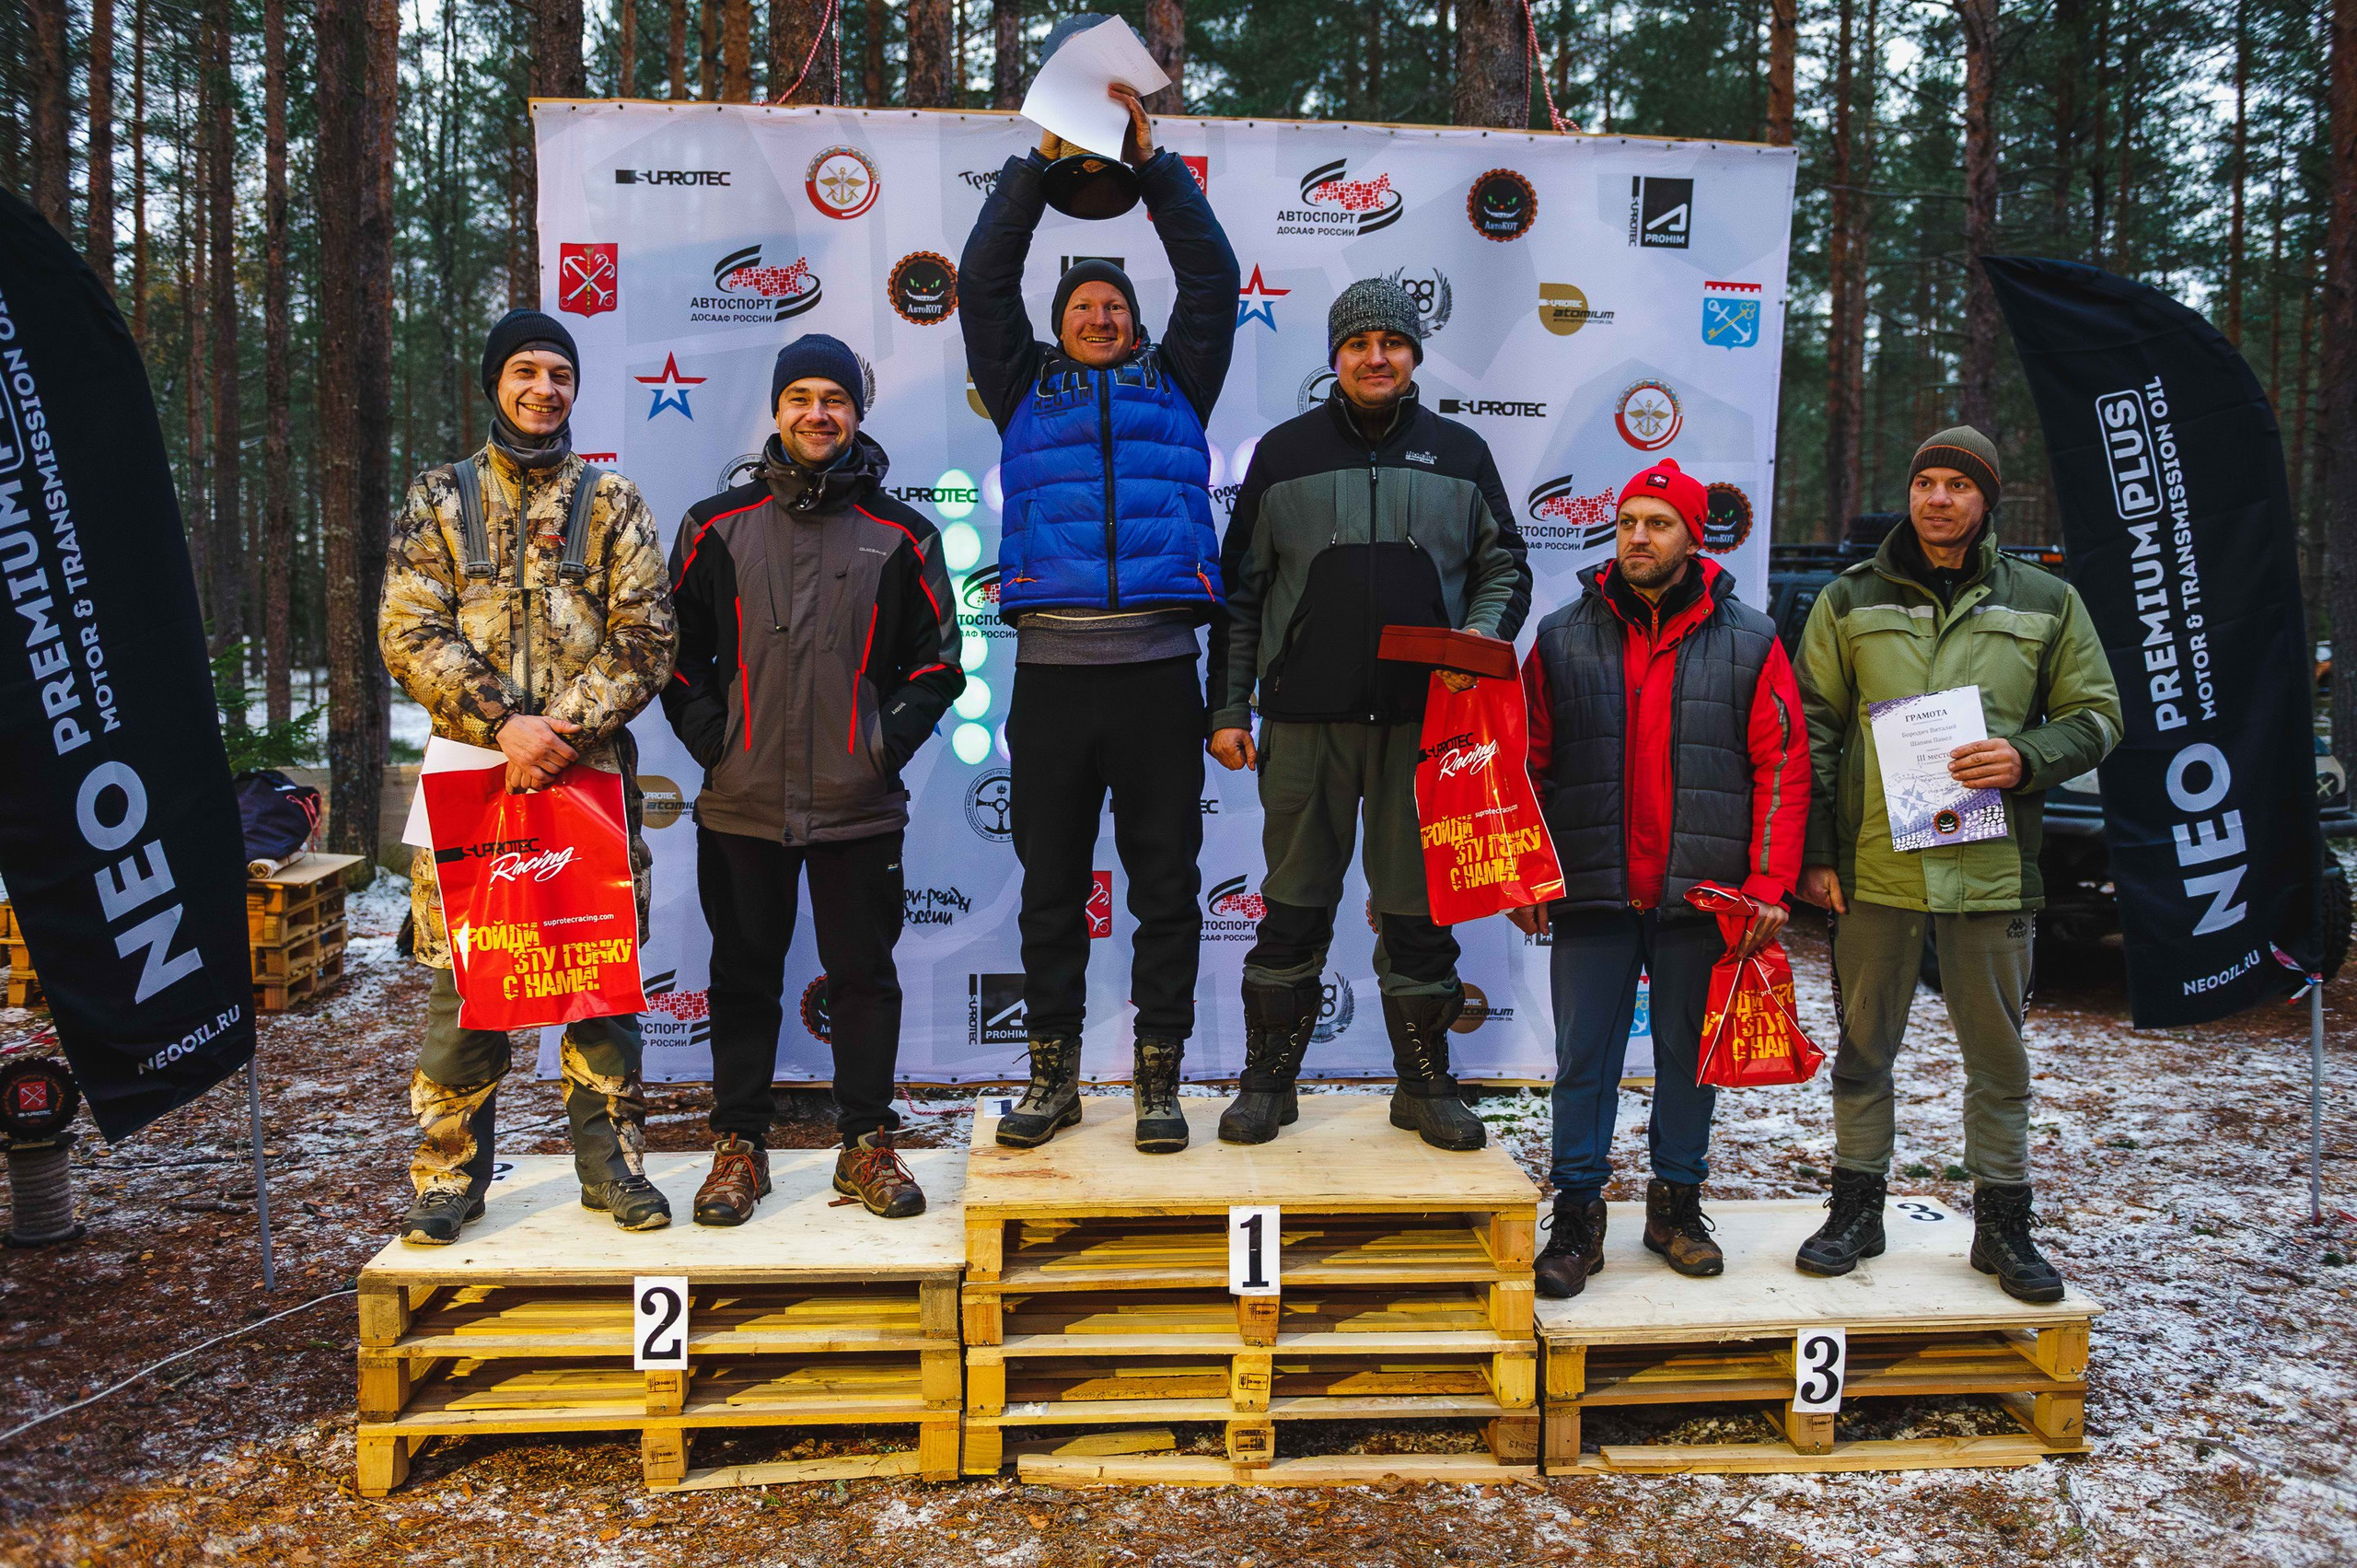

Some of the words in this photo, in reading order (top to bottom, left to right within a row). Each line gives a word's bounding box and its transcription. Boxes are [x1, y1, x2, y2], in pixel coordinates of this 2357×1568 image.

[633, 170, 731, 186] SUPROTEC
[958, 169, 1002, 191] Троф
[1277, 210, 1355, 224] АВТОСПОРТ
[1629, 195, 1641, 247] SUPROTEC
[1277, 226, 1315, 235] ДОСААФ
[1318, 227, 1354, 237] РОССИИ
[1644, 233, 1686, 244] PROHIM
[691, 297, 772, 310] АВТОСПОРТ
[691, 313, 730, 322] ДОСААФ
[733, 314, 772, 323] РОССИИ
[1457, 400, 1547, 417] SUPROTEC
[2144, 376, 2169, 419] OIL
[2104, 399, 2155, 512] PLUS
[4, 348, 88, 595] TRANSMISSION
[888, 487, 979, 503] SUPROTEC
[2154, 423, 2201, 610] TRANSMISSION
[1516, 527, 1581, 539] ВТОСПОРТ
[1526, 541, 1541, 550] ААФ
[1545, 542, 1581, 551] РОССИИ
[0, 479, 91, 756] PREMIUM
[74, 598, 94, 618] &
[958, 614, 1007, 626] ТОСПО
[2128, 521, 2189, 731] PREMIUM
[2187, 615, 2204, 629] &
[80, 622, 121, 733] MOTOR
[2190, 633, 2217, 721] MOTOR
[1905, 709, 1948, 722] ГРАМОТА
[1427, 732, 1473, 758] SUPROTEC
[1927, 751, 1951, 761] место
[1439, 739, 1499, 781] Racing
[462, 838, 540, 859] SUPROTEC
[1455, 836, 1483, 865] ЭТУ
[2165, 742, 2248, 936] NEO
[489, 847, 583, 884] Racing
[76, 761, 203, 1005] NEO
[543, 912, 615, 927] suprotecracing.com
[1201, 921, 1256, 931] ТОСПОРТ
[514, 945, 557, 974] ЭТУ
[563, 938, 633, 969] ГОНКУ
[526, 967, 600, 999] НАМИ!
[2183, 949, 2259, 996] NEOOIL.RU
[969, 995, 978, 1045] SUPROTEC
[1464, 1007, 1514, 1016] tomium
[139, 1005, 240, 1076] NEOOIL.RU
[985, 1029, 1028, 1040] PROHIM
[1897, 1202, 1945, 1223] 3
[1238, 1214, 1270, 1288] 1
[640, 1286, 682, 1361] 2
[1800, 1335, 1840, 1405] 3
